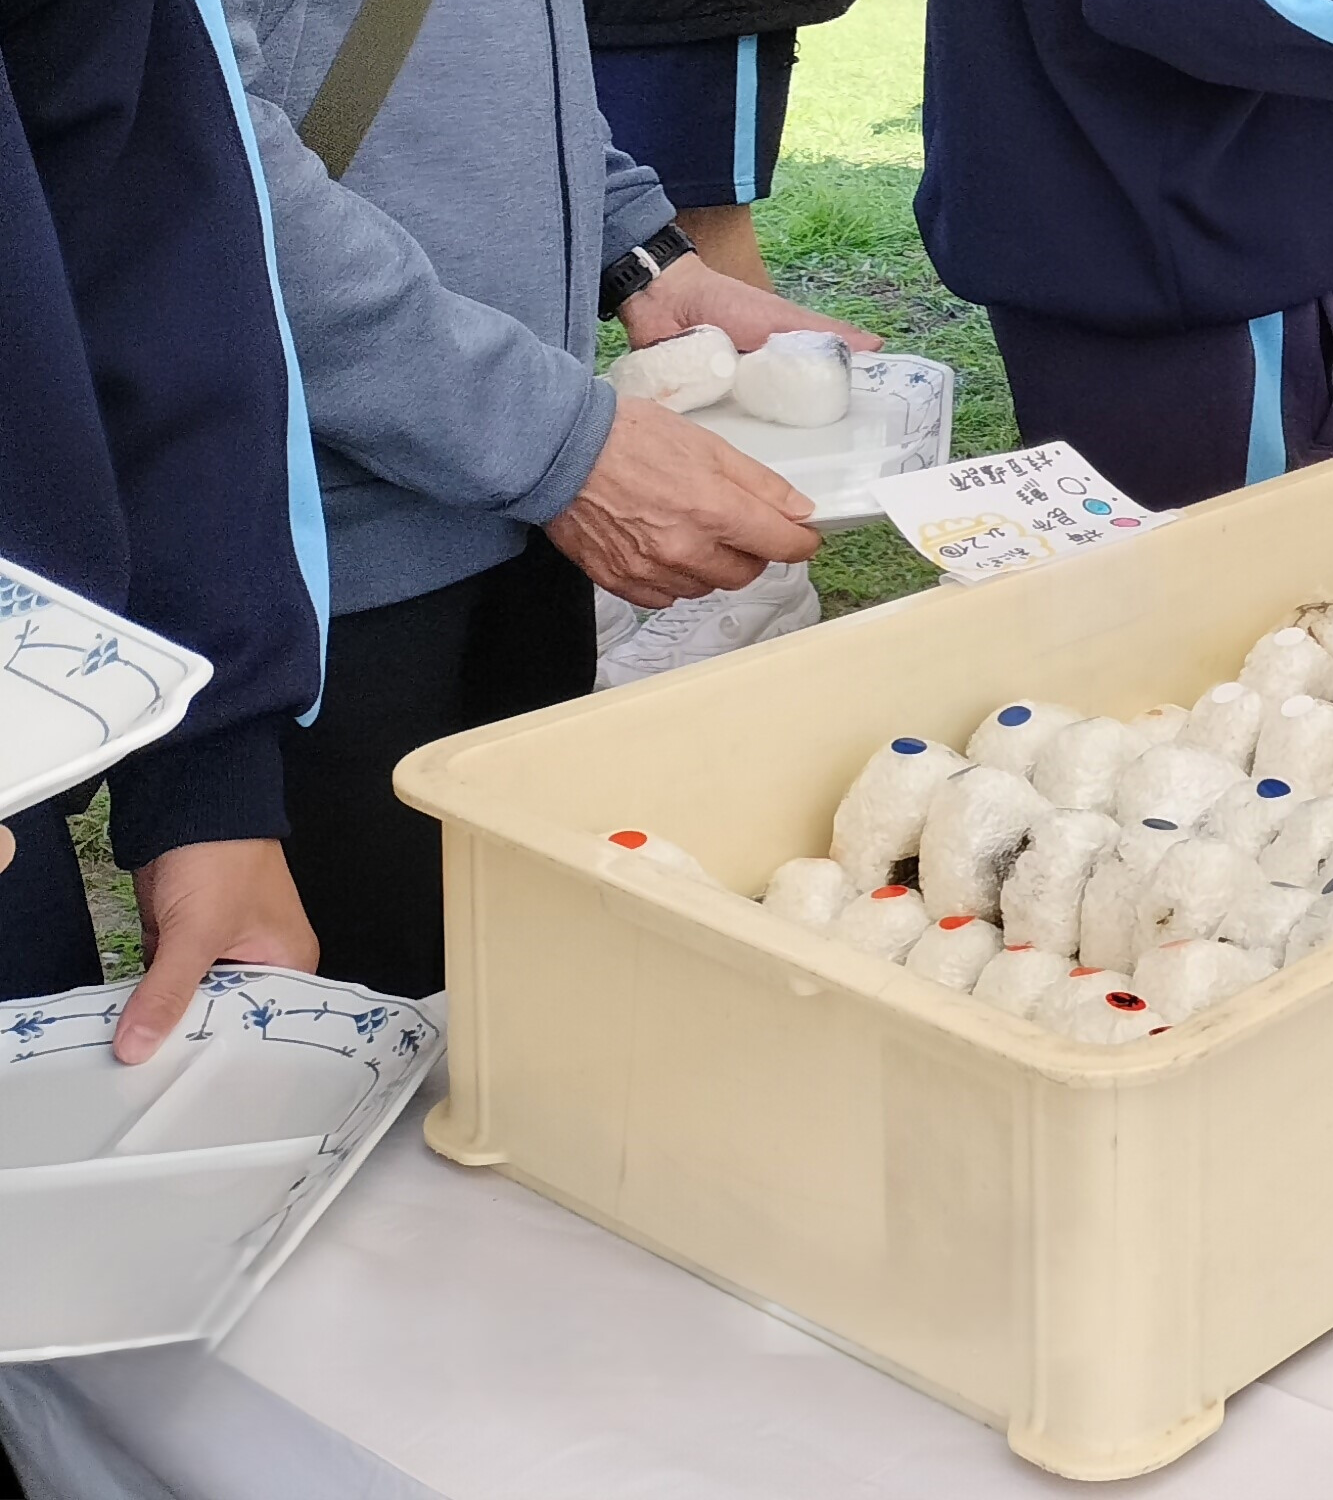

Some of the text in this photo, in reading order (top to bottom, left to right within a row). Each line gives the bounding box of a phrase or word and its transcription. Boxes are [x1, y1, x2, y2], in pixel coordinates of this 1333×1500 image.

[1016, 478, 1049, 506] 鮭
[1032, 507, 1078, 533] 昆布
[975, 546, 1032, 570] おにぎり
